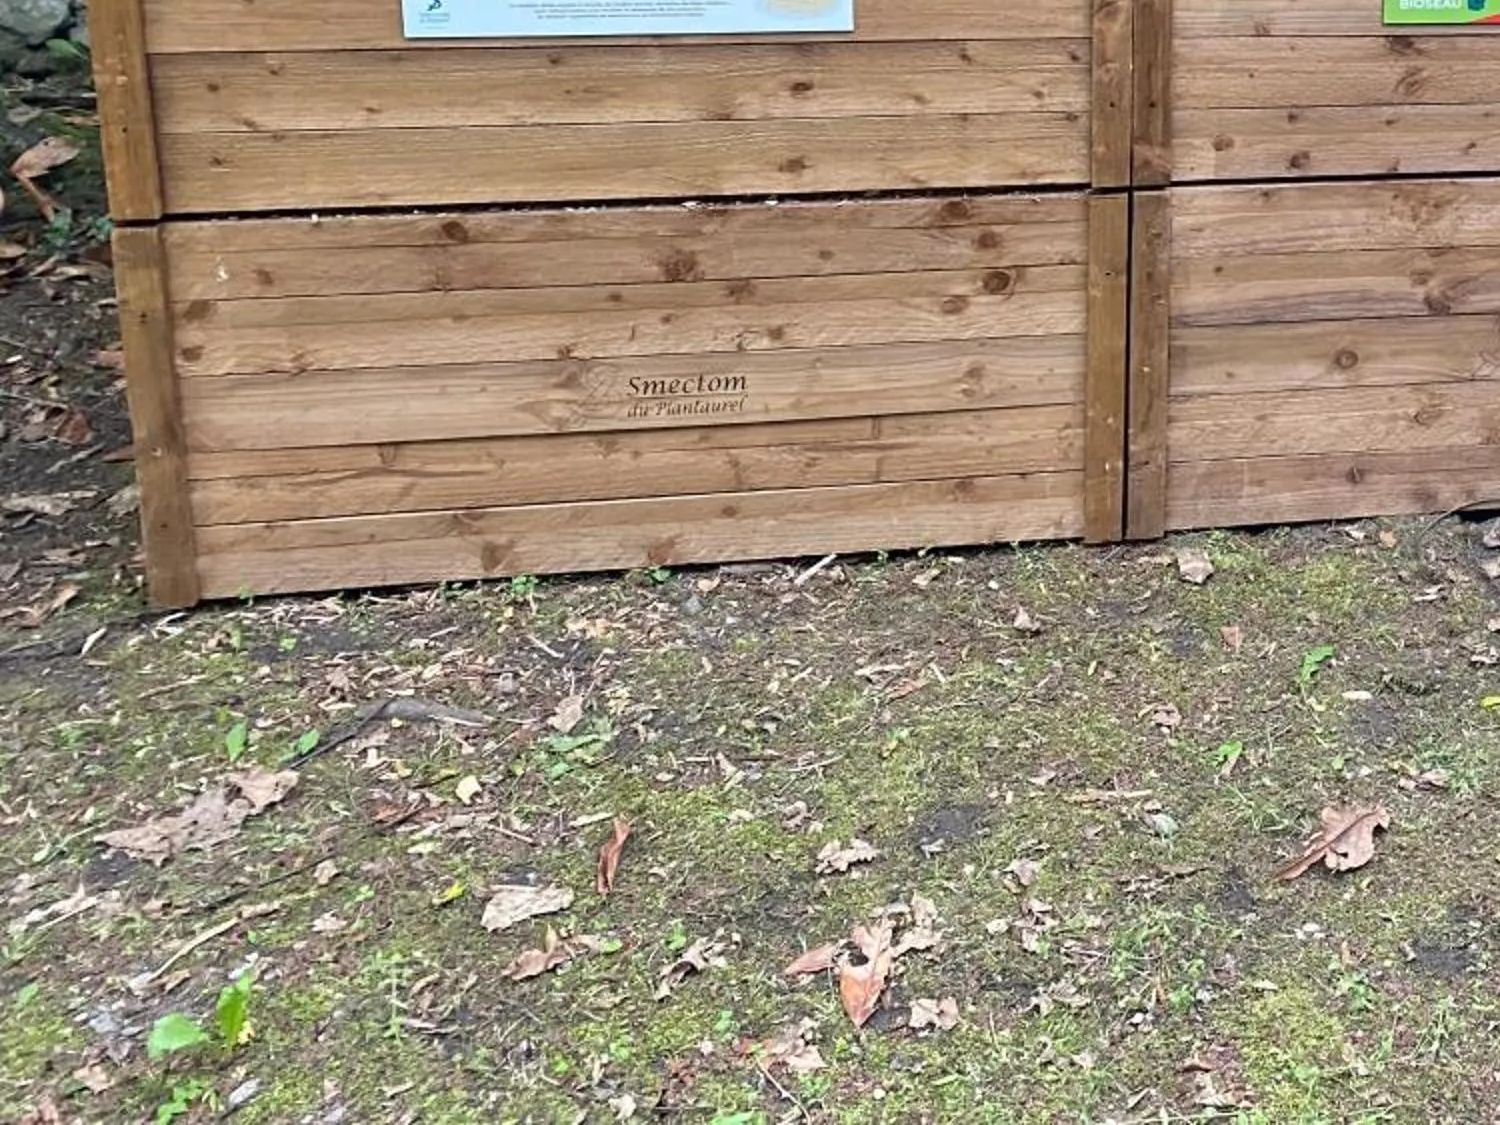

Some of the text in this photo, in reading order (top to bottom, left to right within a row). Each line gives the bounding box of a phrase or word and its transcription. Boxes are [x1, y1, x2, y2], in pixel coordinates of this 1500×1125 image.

[626, 374, 747, 396] Smectom
[626, 394, 749, 418] du Plantaurel
